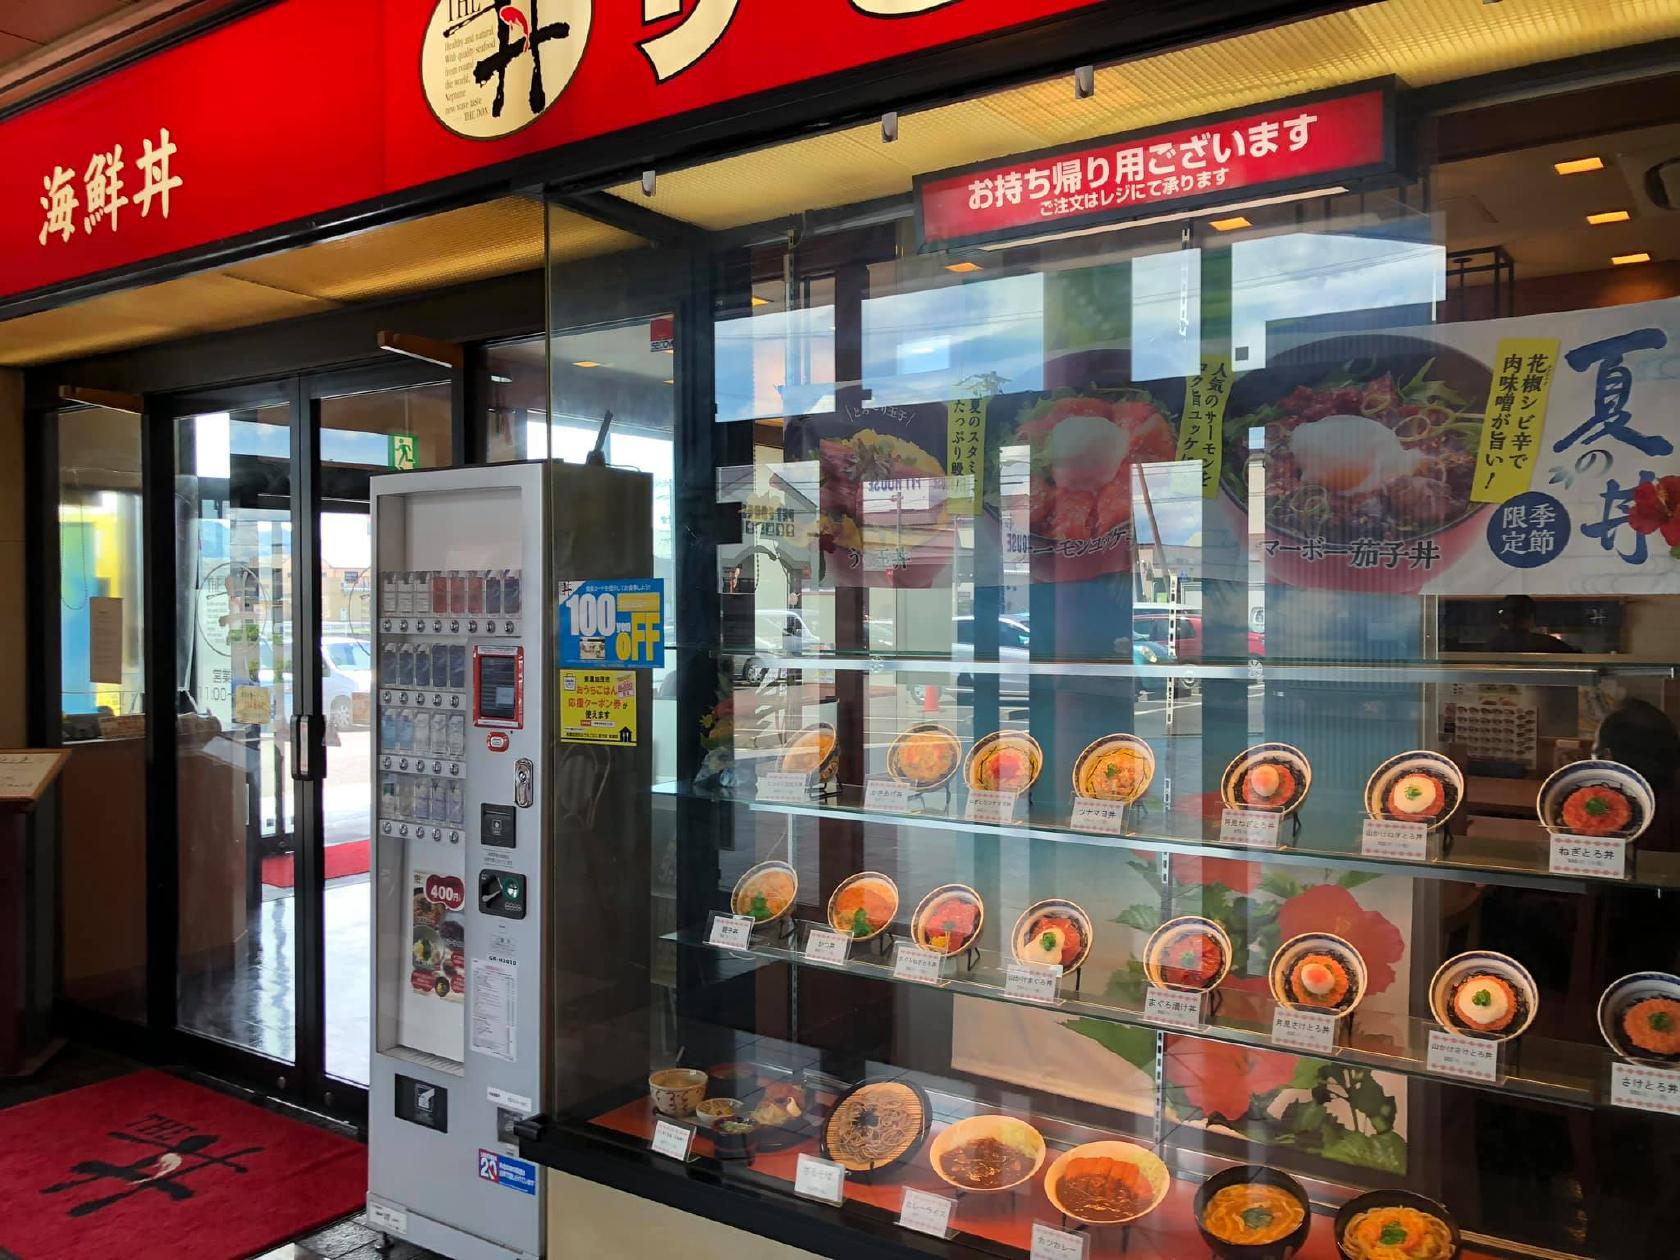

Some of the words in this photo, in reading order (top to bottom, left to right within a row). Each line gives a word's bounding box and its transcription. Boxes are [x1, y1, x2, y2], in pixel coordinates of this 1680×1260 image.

[464, 33, 474, 44] and
[967, 112, 1319, 211] お持ち帰り用ございます
[38, 127, 184, 247] 海鮮丼
[1038, 167, 1230, 218] ご注文はレジにて承ります
[1509, 353, 1549, 470] 花椒シビ辛で
[1259, 536, 1441, 570] マーボー茄子丼
[566, 593, 616, 637] 100
[616, 612, 660, 661] OFF
[585, 710, 610, 720] 使えます
[1558, 847, 1616, 860] ねぎとろ丼
[1148, 998, 1198, 1014] まぐろ漬け丼
[1431, 1042, 1495, 1059] 山かけさけとろ丼
[1622, 1076, 1679, 1095] さけとろ丼
